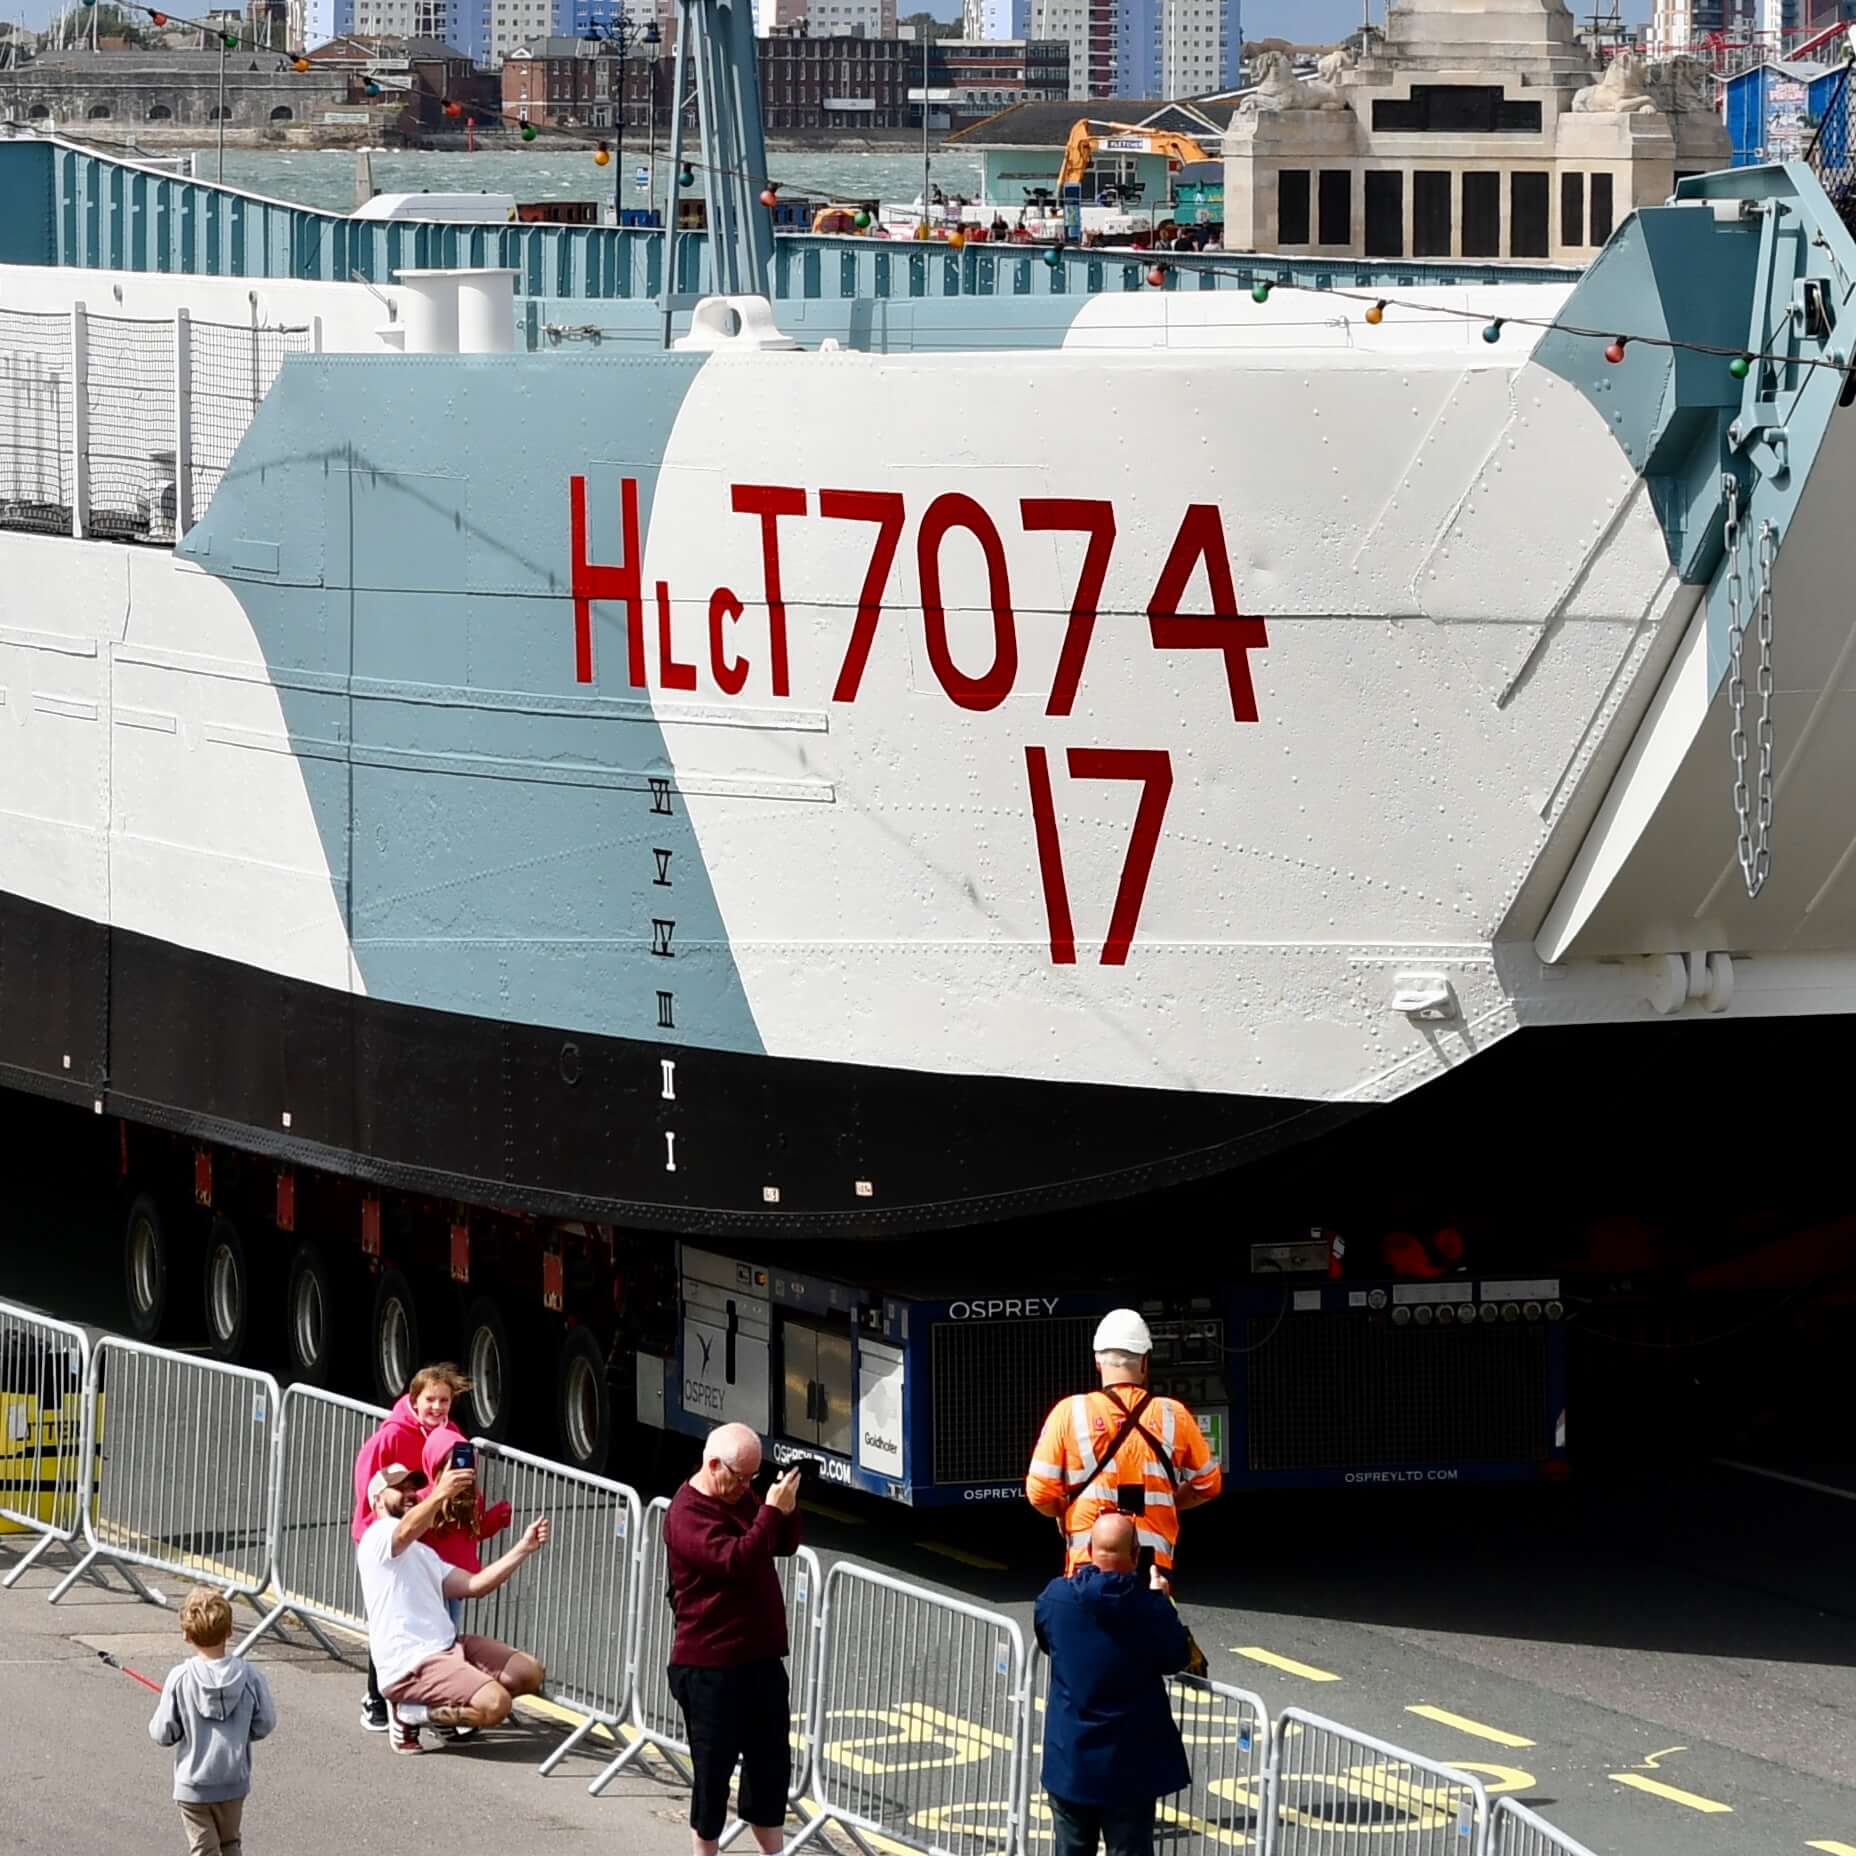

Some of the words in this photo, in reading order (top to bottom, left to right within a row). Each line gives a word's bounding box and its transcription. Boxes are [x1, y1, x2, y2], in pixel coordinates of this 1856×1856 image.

[647, 778, 673, 815] VI
[652, 848, 673, 886] V
[1024, 746, 1174, 966] 17
[651, 918, 675, 957] IV
[655, 990, 675, 1028] III
[660, 1059, 676, 1100] II
[948, 1297, 1060, 1319] OSPREY
[684, 1378, 726, 1411] OSPREY
[773, 1442, 852, 1484] OSPREYD.COM
